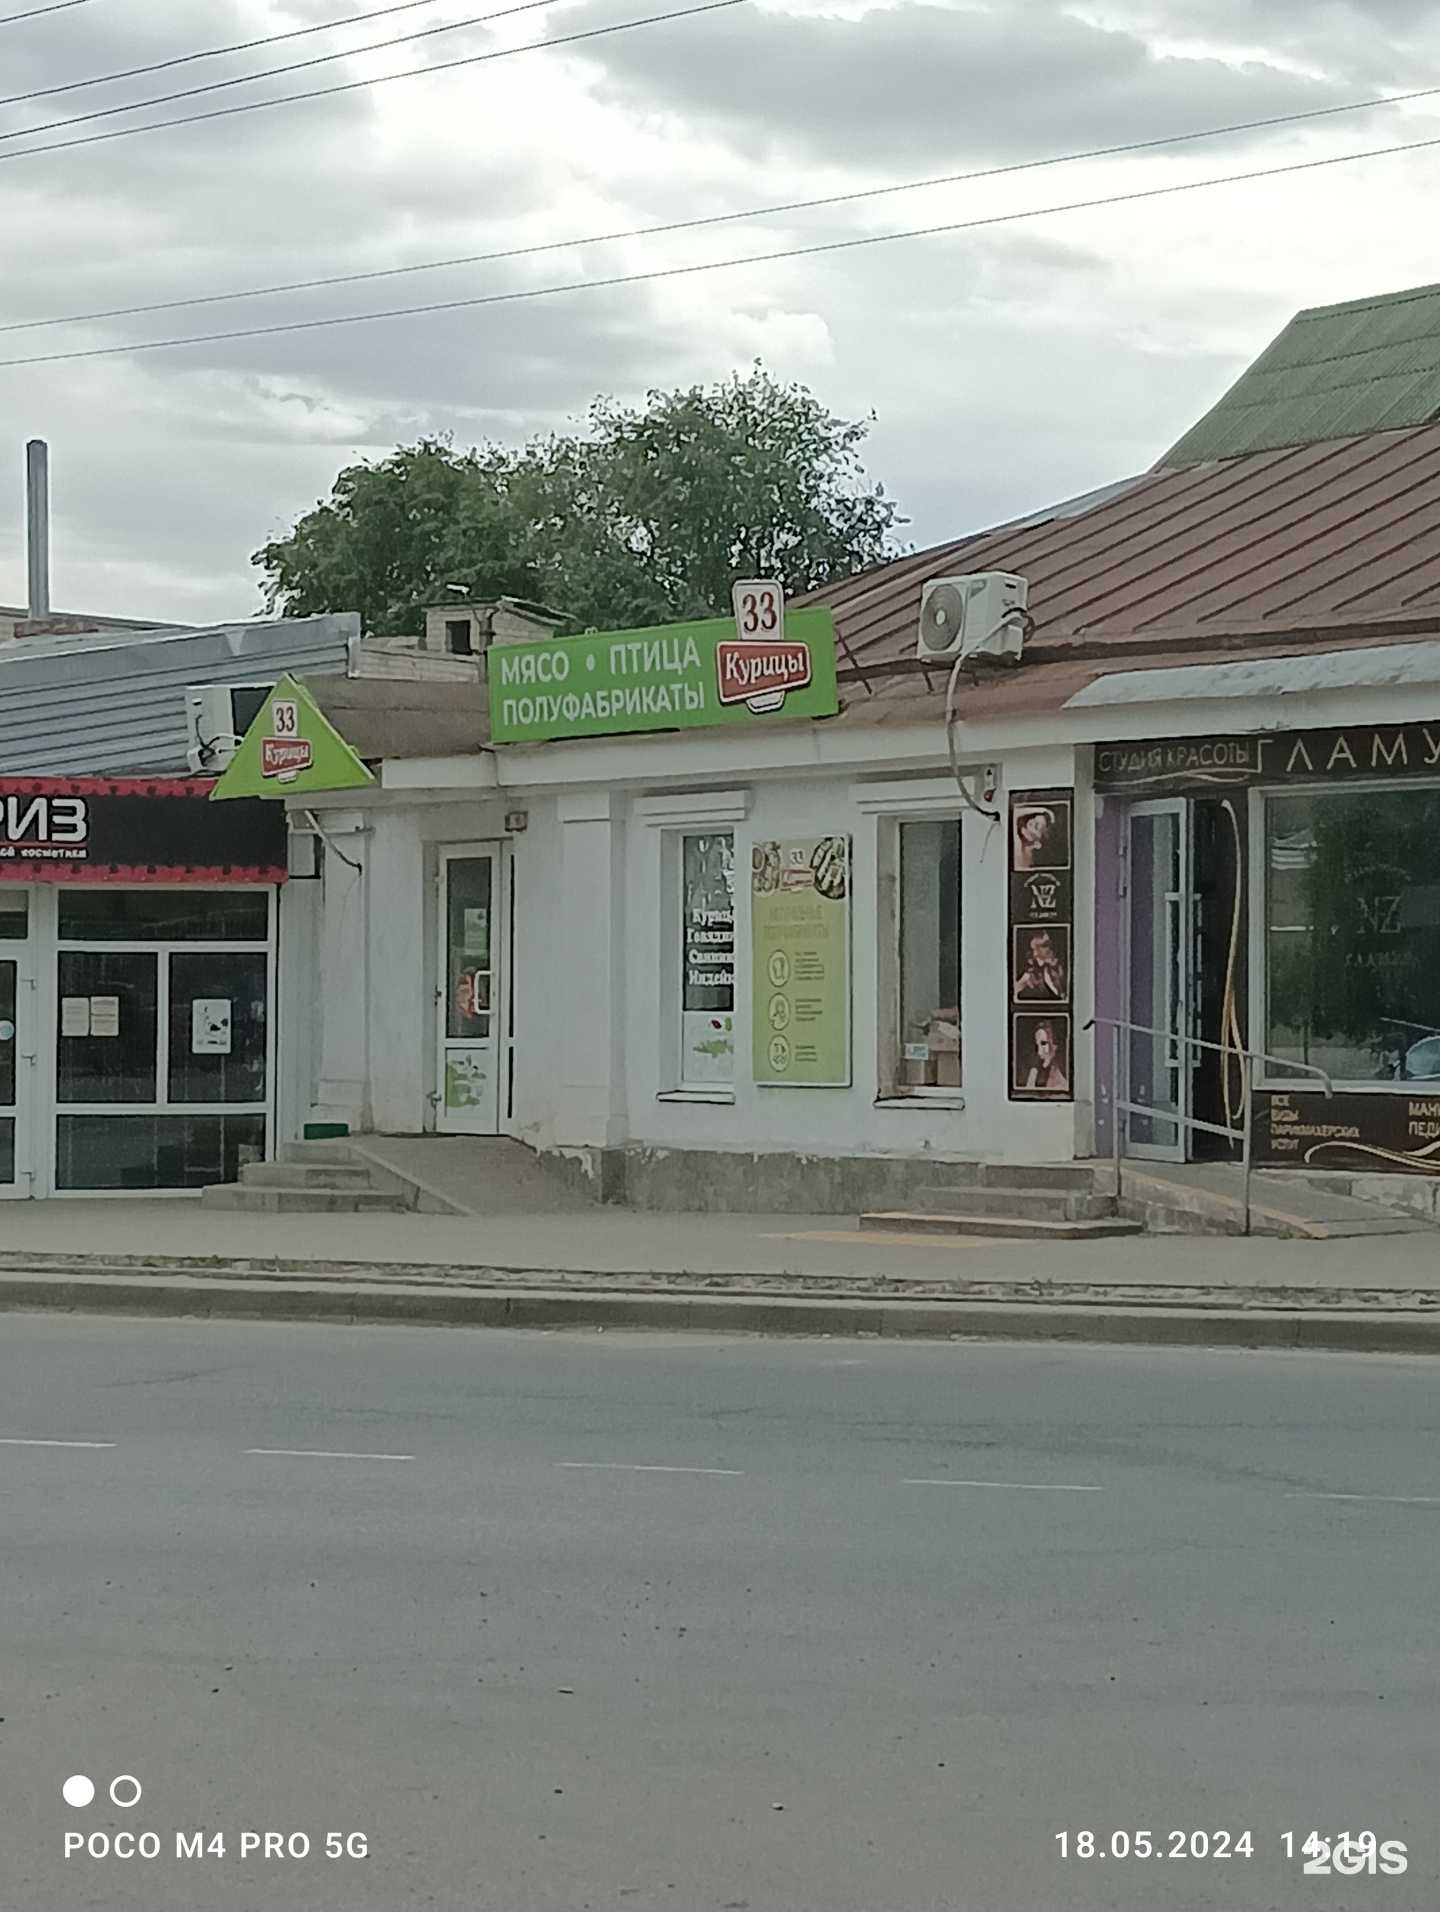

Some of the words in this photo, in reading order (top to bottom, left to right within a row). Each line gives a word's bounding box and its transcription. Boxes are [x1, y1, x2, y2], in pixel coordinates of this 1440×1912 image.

[742, 591, 777, 633] 33
[501, 650, 570, 686] МЯСО
[610, 637, 701, 676] ПТИЦА
[724, 651, 806, 686] Курицы
[276, 706, 295, 732] 33
[503, 681, 705, 726] ПОЛУФАБРИКАТЫ
[1099, 748, 1162, 772] СТУДИЯ
[1167, 742, 1249, 767] КРАСОТЫ
[0, 796, 87, 842] ИЗ
